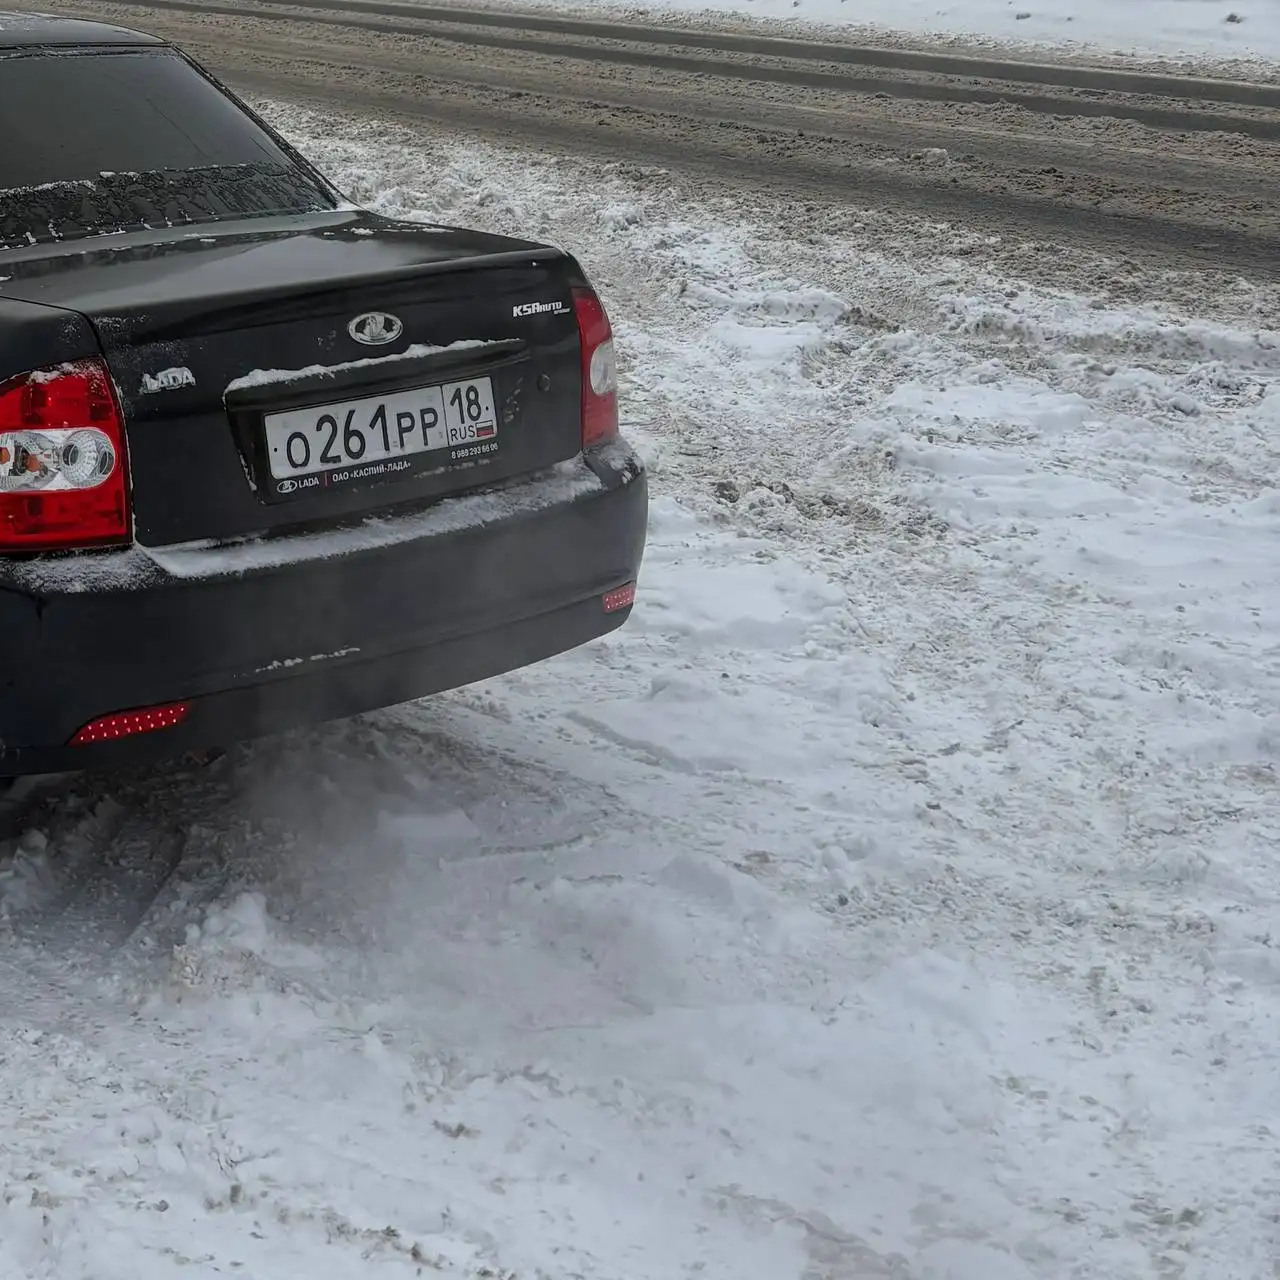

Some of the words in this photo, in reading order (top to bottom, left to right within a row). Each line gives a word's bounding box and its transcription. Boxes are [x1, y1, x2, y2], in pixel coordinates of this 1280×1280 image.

[449, 385, 481, 424] 18
[450, 427, 476, 442] RUS
[298, 477, 320, 489] LADA
[332, 471, 349, 483] ОАО
